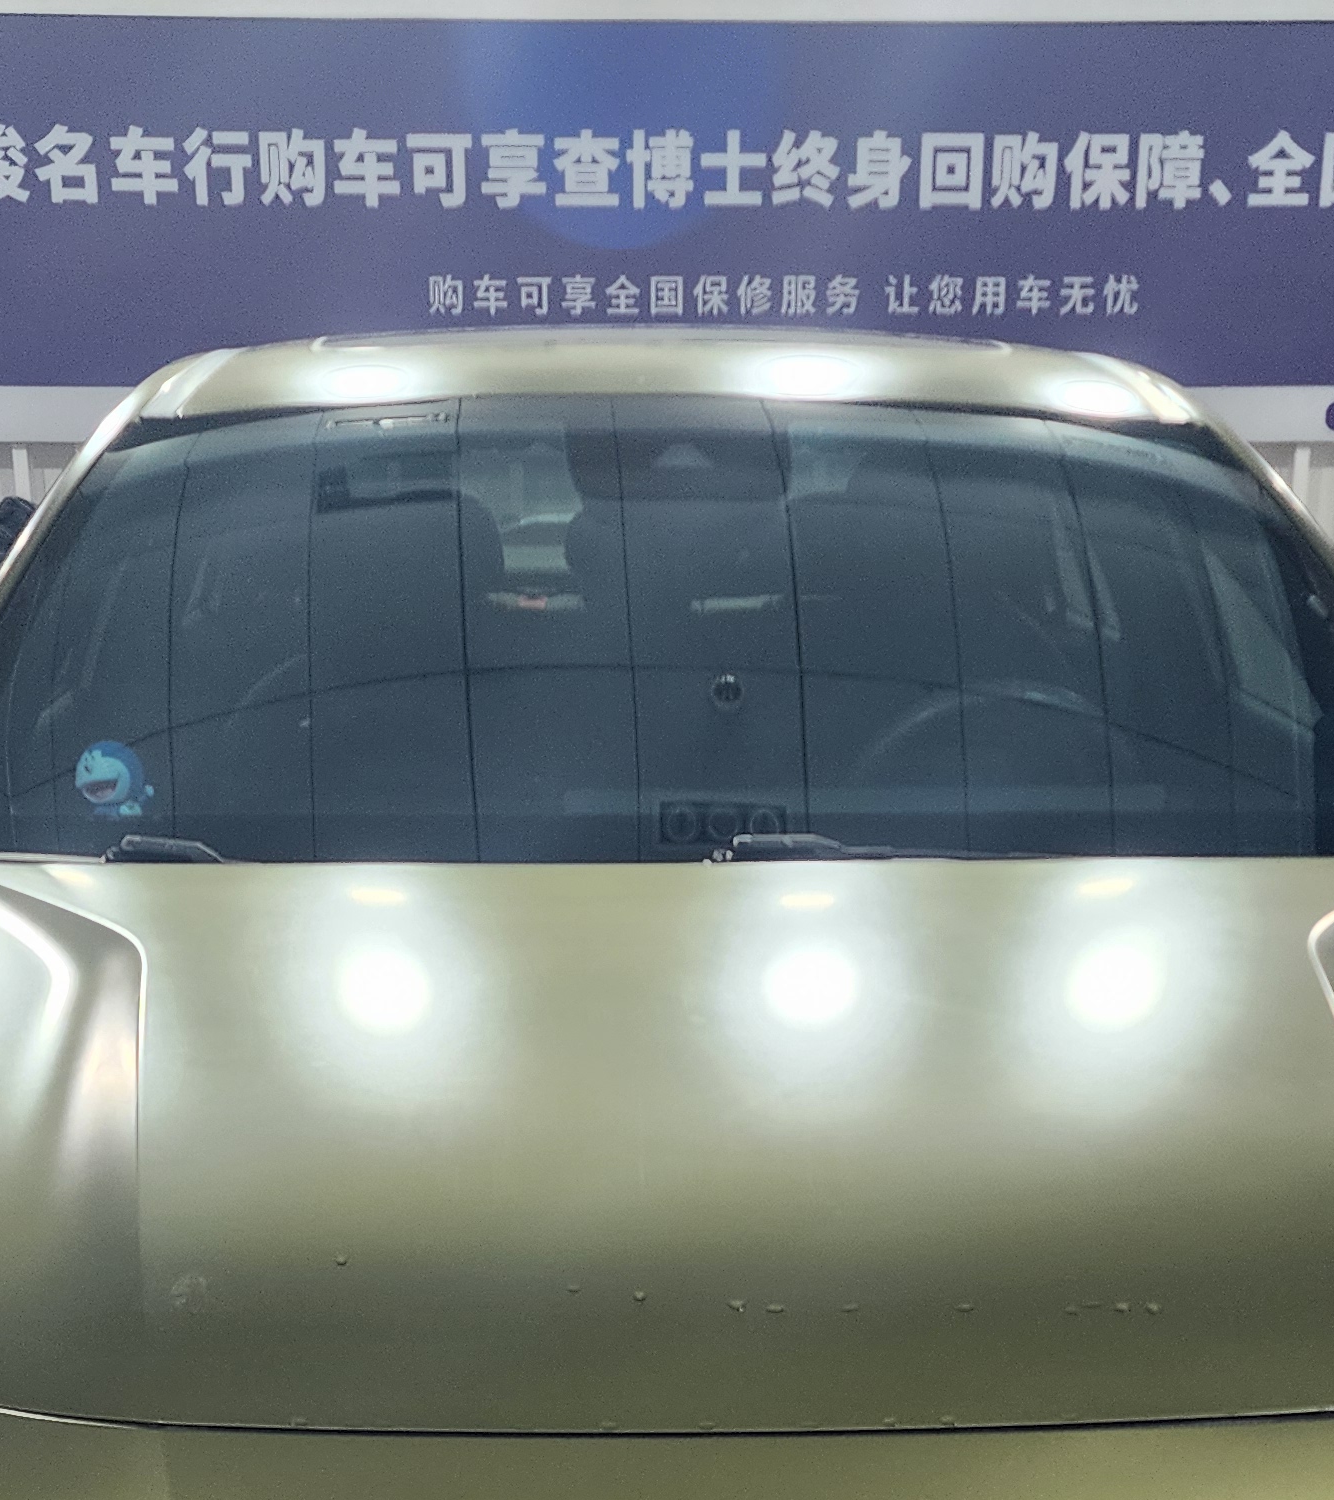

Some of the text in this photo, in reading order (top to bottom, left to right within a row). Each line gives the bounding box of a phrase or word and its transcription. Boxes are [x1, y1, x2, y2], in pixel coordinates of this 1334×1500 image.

[427, 272, 1141, 320] 购车可享全国保修服务 让您用车无忧
